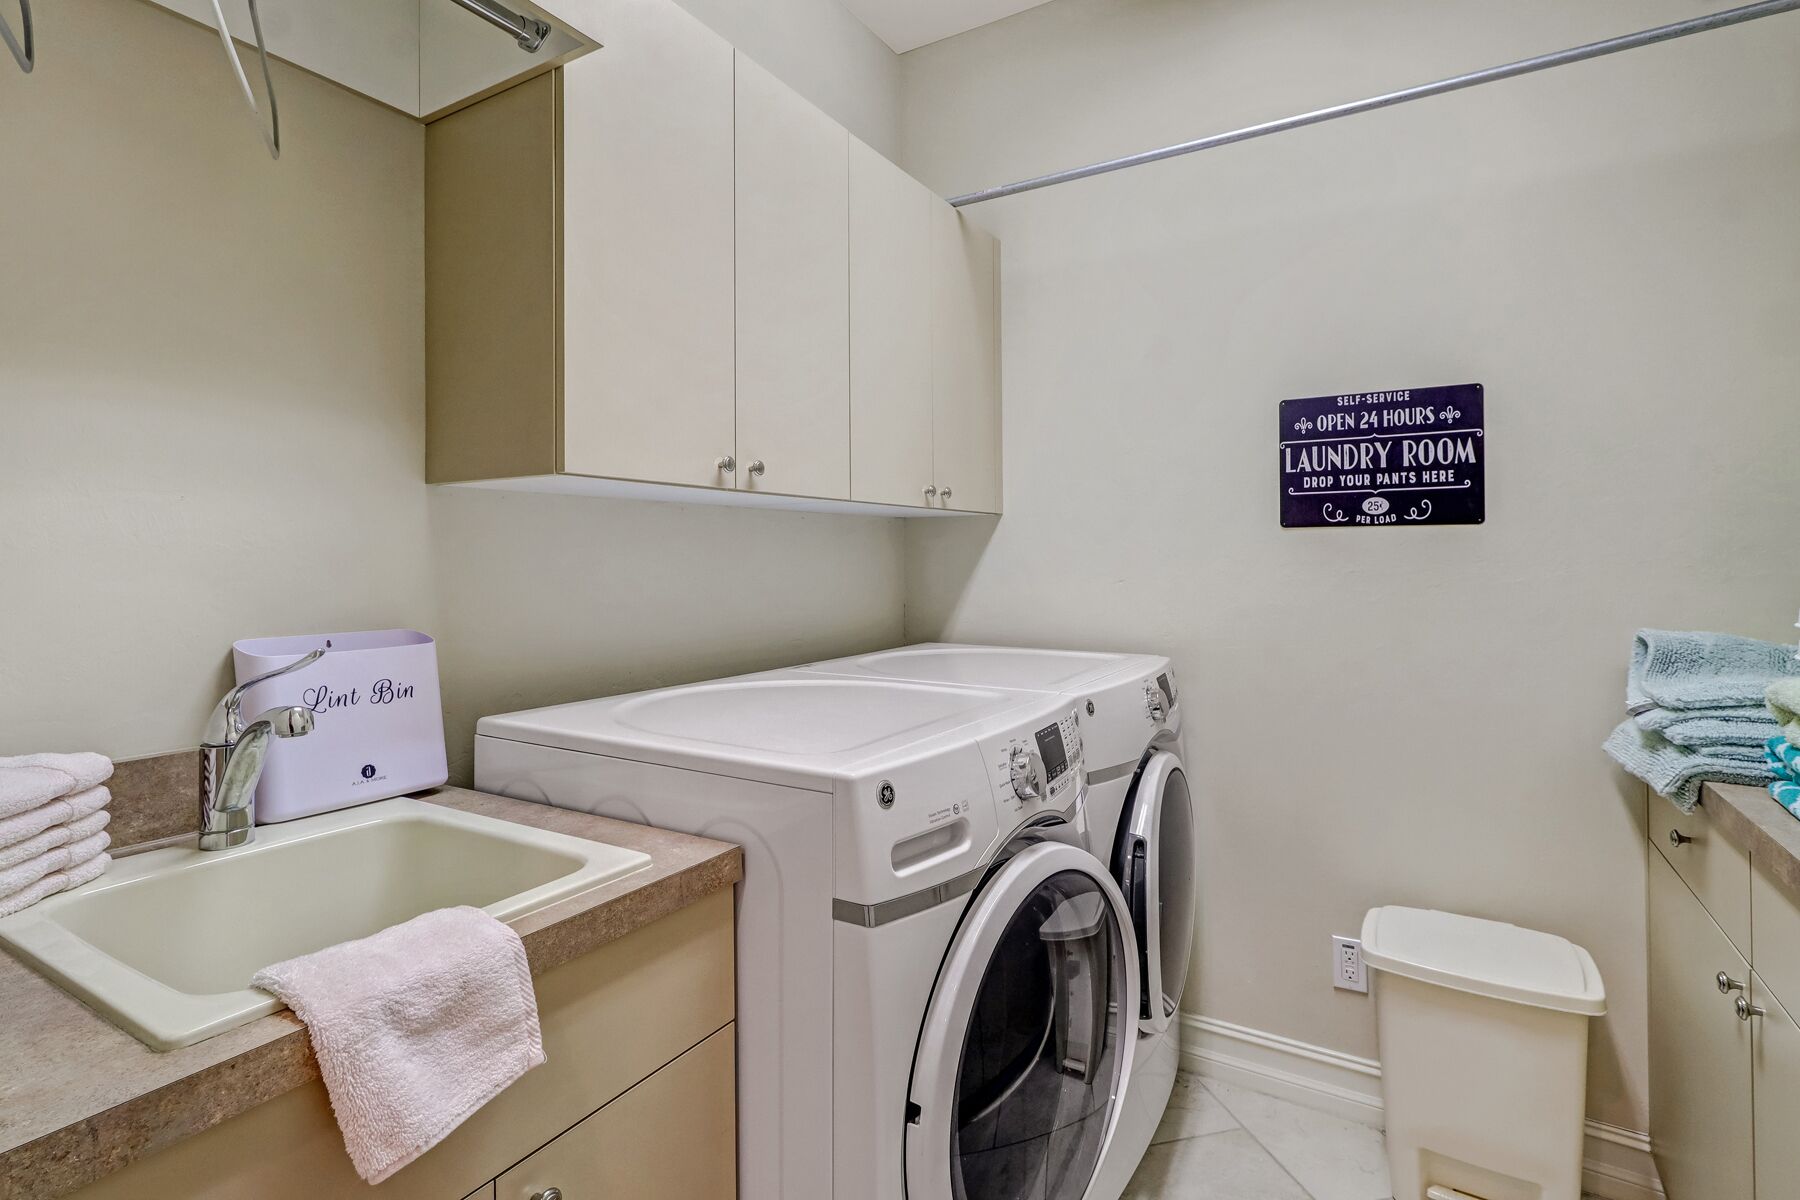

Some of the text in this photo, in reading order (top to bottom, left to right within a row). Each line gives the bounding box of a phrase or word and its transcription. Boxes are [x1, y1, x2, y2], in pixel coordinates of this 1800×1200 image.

[1337, 390, 1410, 406] SELF-SERVICE
[1316, 406, 1435, 432] OPEN 24 HOURS
[1285, 436, 1476, 473] LAUNDRY ROOM
[1303, 470, 1455, 488] DROP YOUR PANTS HERE
[1355, 513, 1397, 525] PER LOAD
[303, 678, 414, 714] Lint Bin
